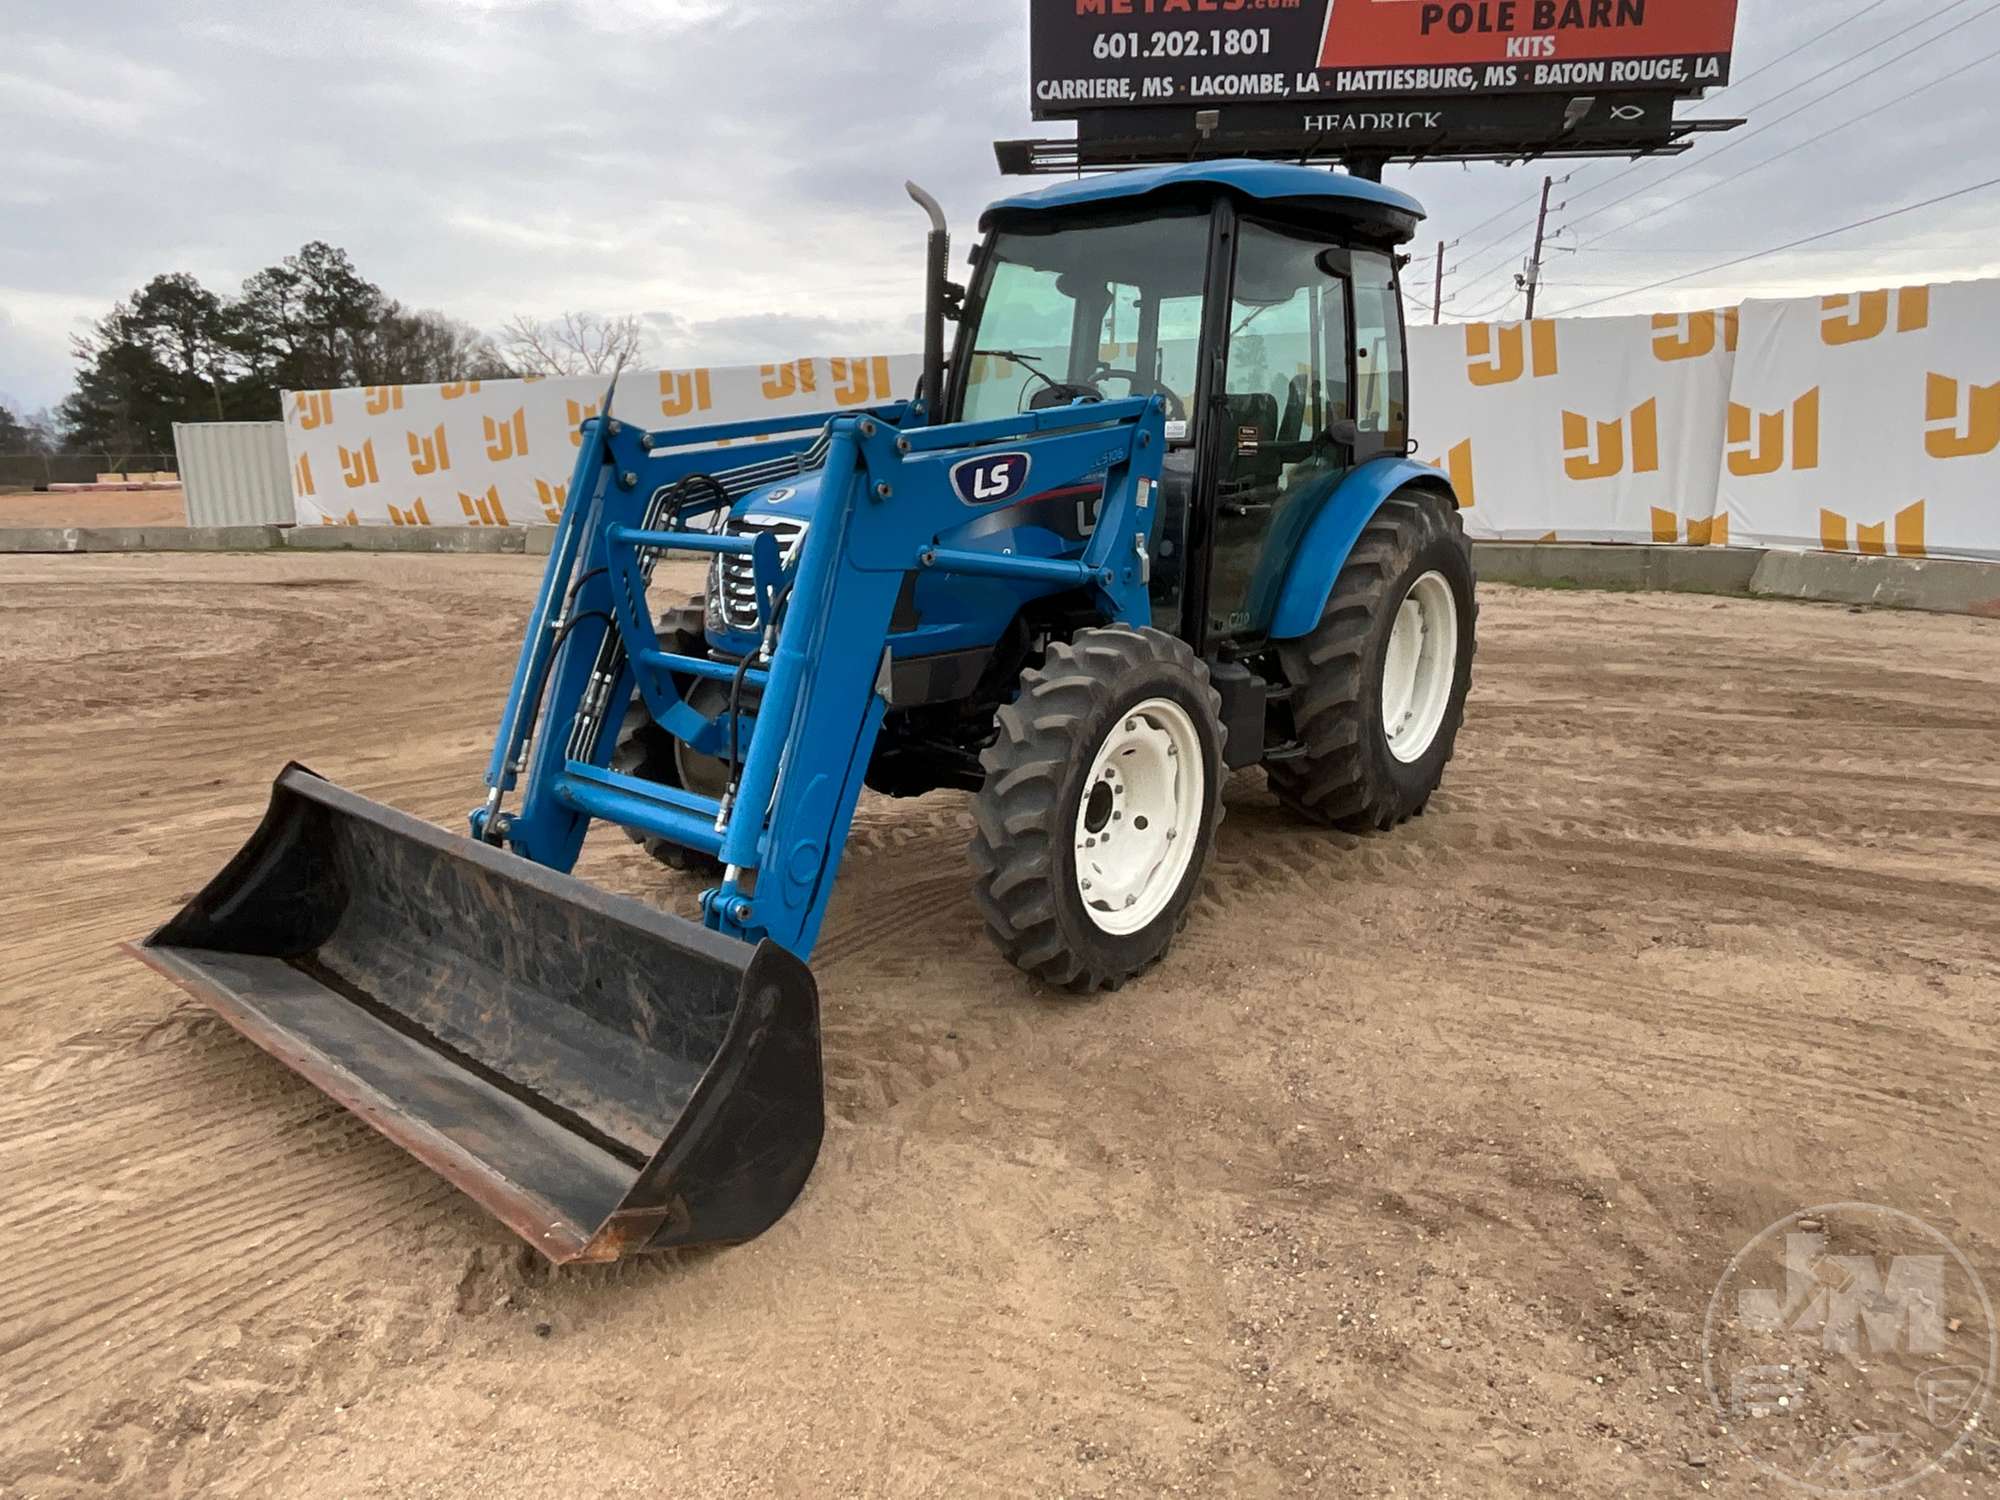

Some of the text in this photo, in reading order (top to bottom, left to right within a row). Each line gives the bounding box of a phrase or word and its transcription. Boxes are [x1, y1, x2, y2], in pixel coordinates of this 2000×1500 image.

[1420, 0, 1645, 36] POLE BARN
[1092, 28, 1270, 59] 601.202.1801
[1506, 35, 1556, 58] KITS
[1036, 57, 1720, 101] CARRIERE, MS LACOMBE, LA HATTIESBURG, MS BATON ROUGE, LA
[1303, 111, 1442, 132] HEADRICK
[973, 460, 1013, 499] LS
